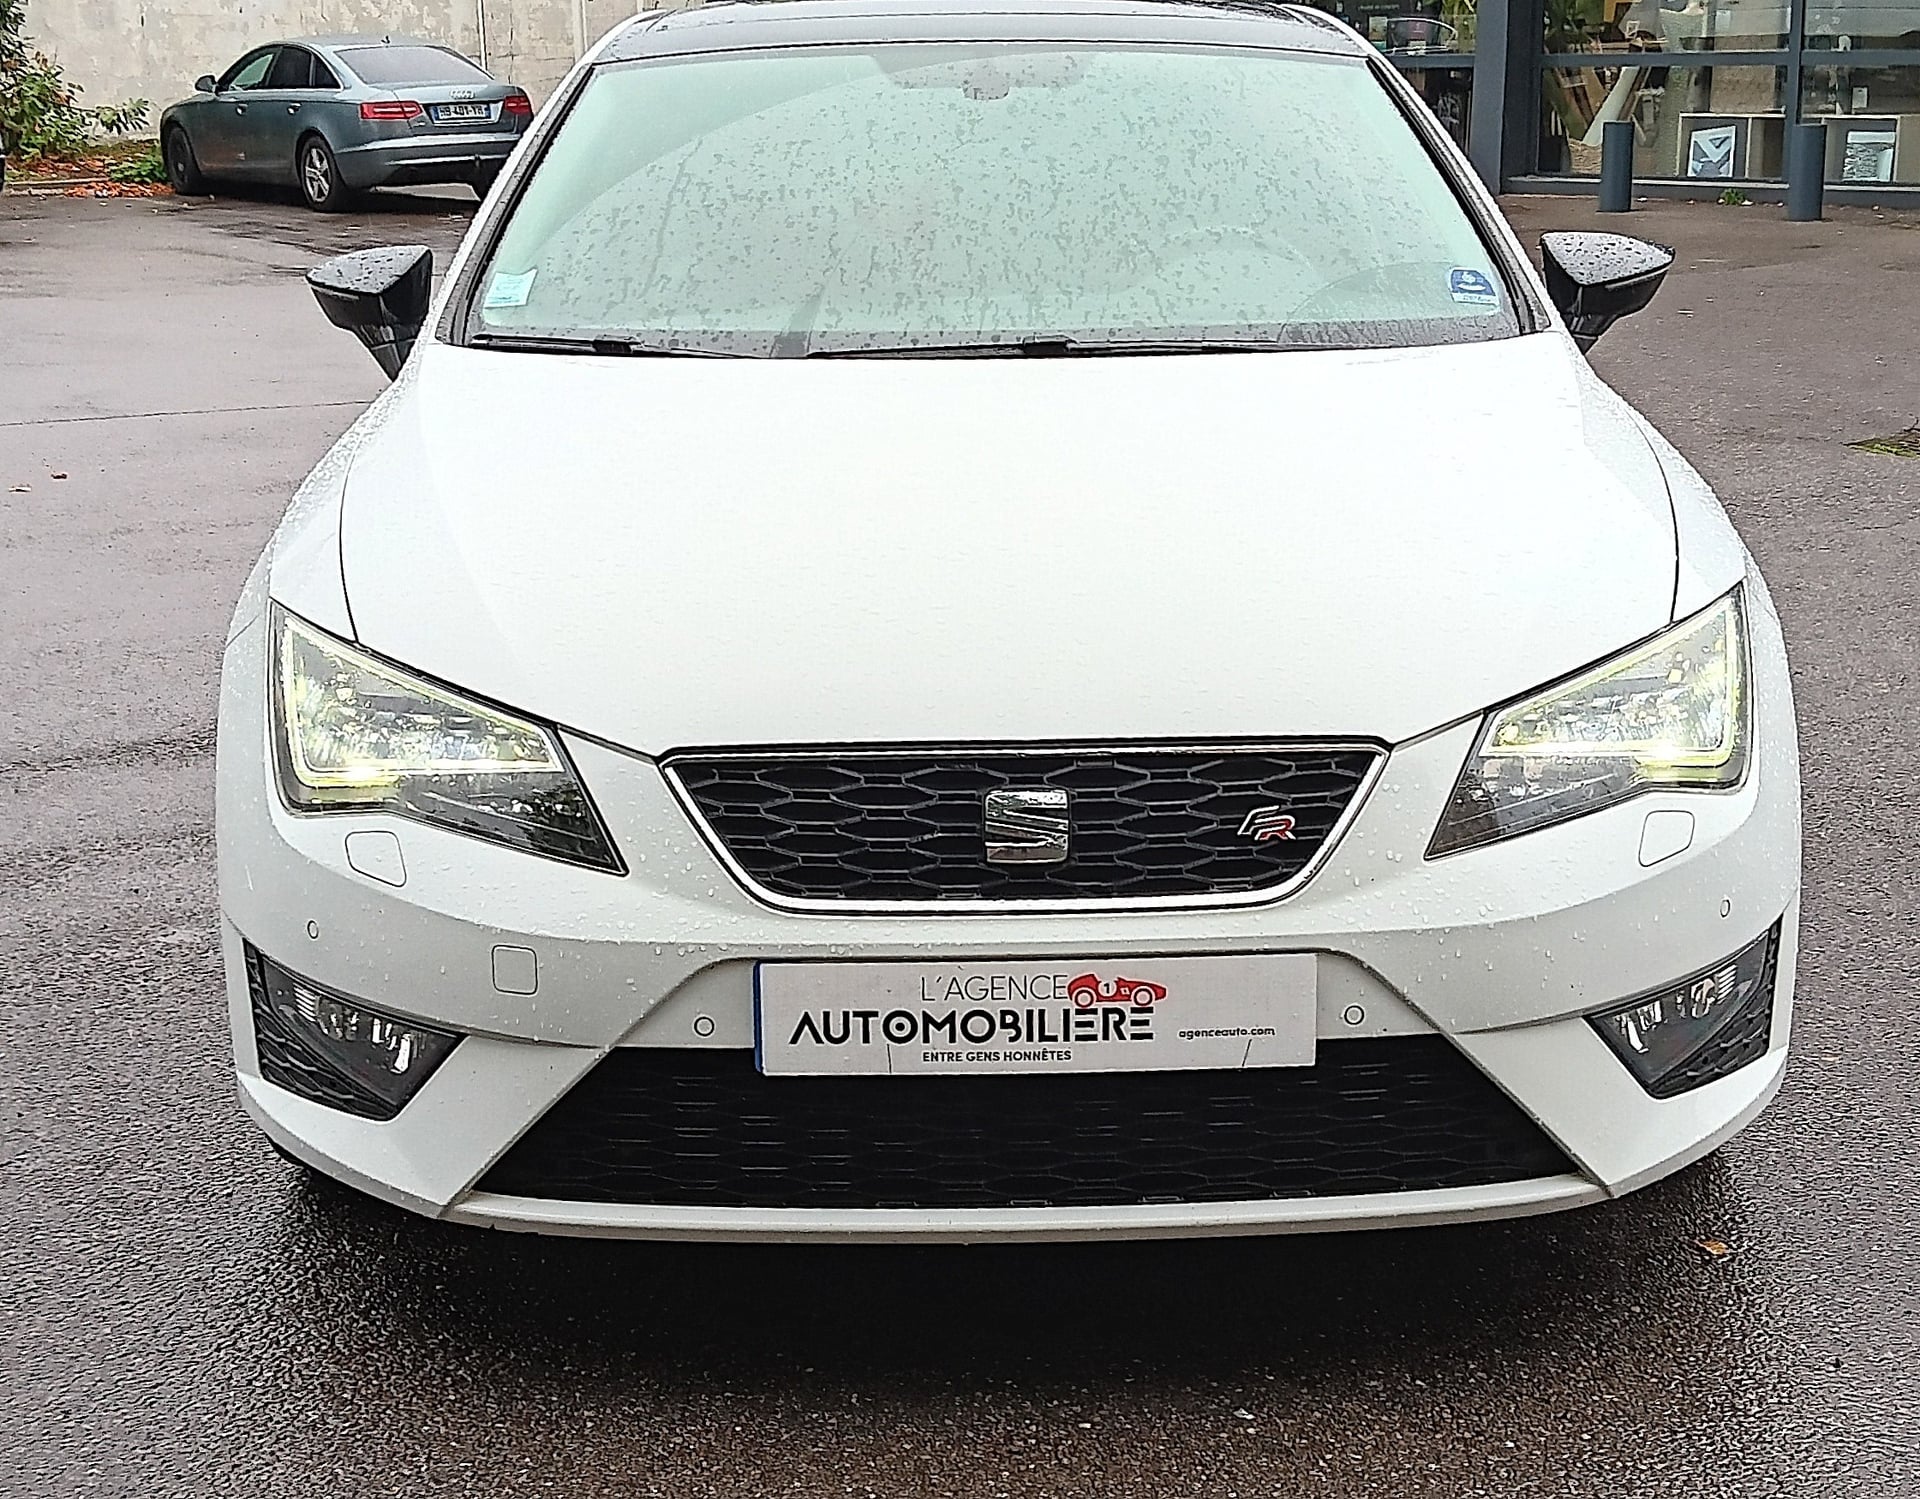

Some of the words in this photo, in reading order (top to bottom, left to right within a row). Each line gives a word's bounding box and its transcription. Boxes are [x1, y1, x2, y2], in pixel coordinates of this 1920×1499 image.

[1237, 805, 1296, 840] FR
[921, 974, 1068, 1001] L'AGENCE
[1178, 1027, 1276, 1040] agenceauto.com
[922, 1051, 963, 1062] ENTRE
[965, 1051, 1000, 1062] GENS
[1003, 1047, 1072, 1062] HONNÊTES
